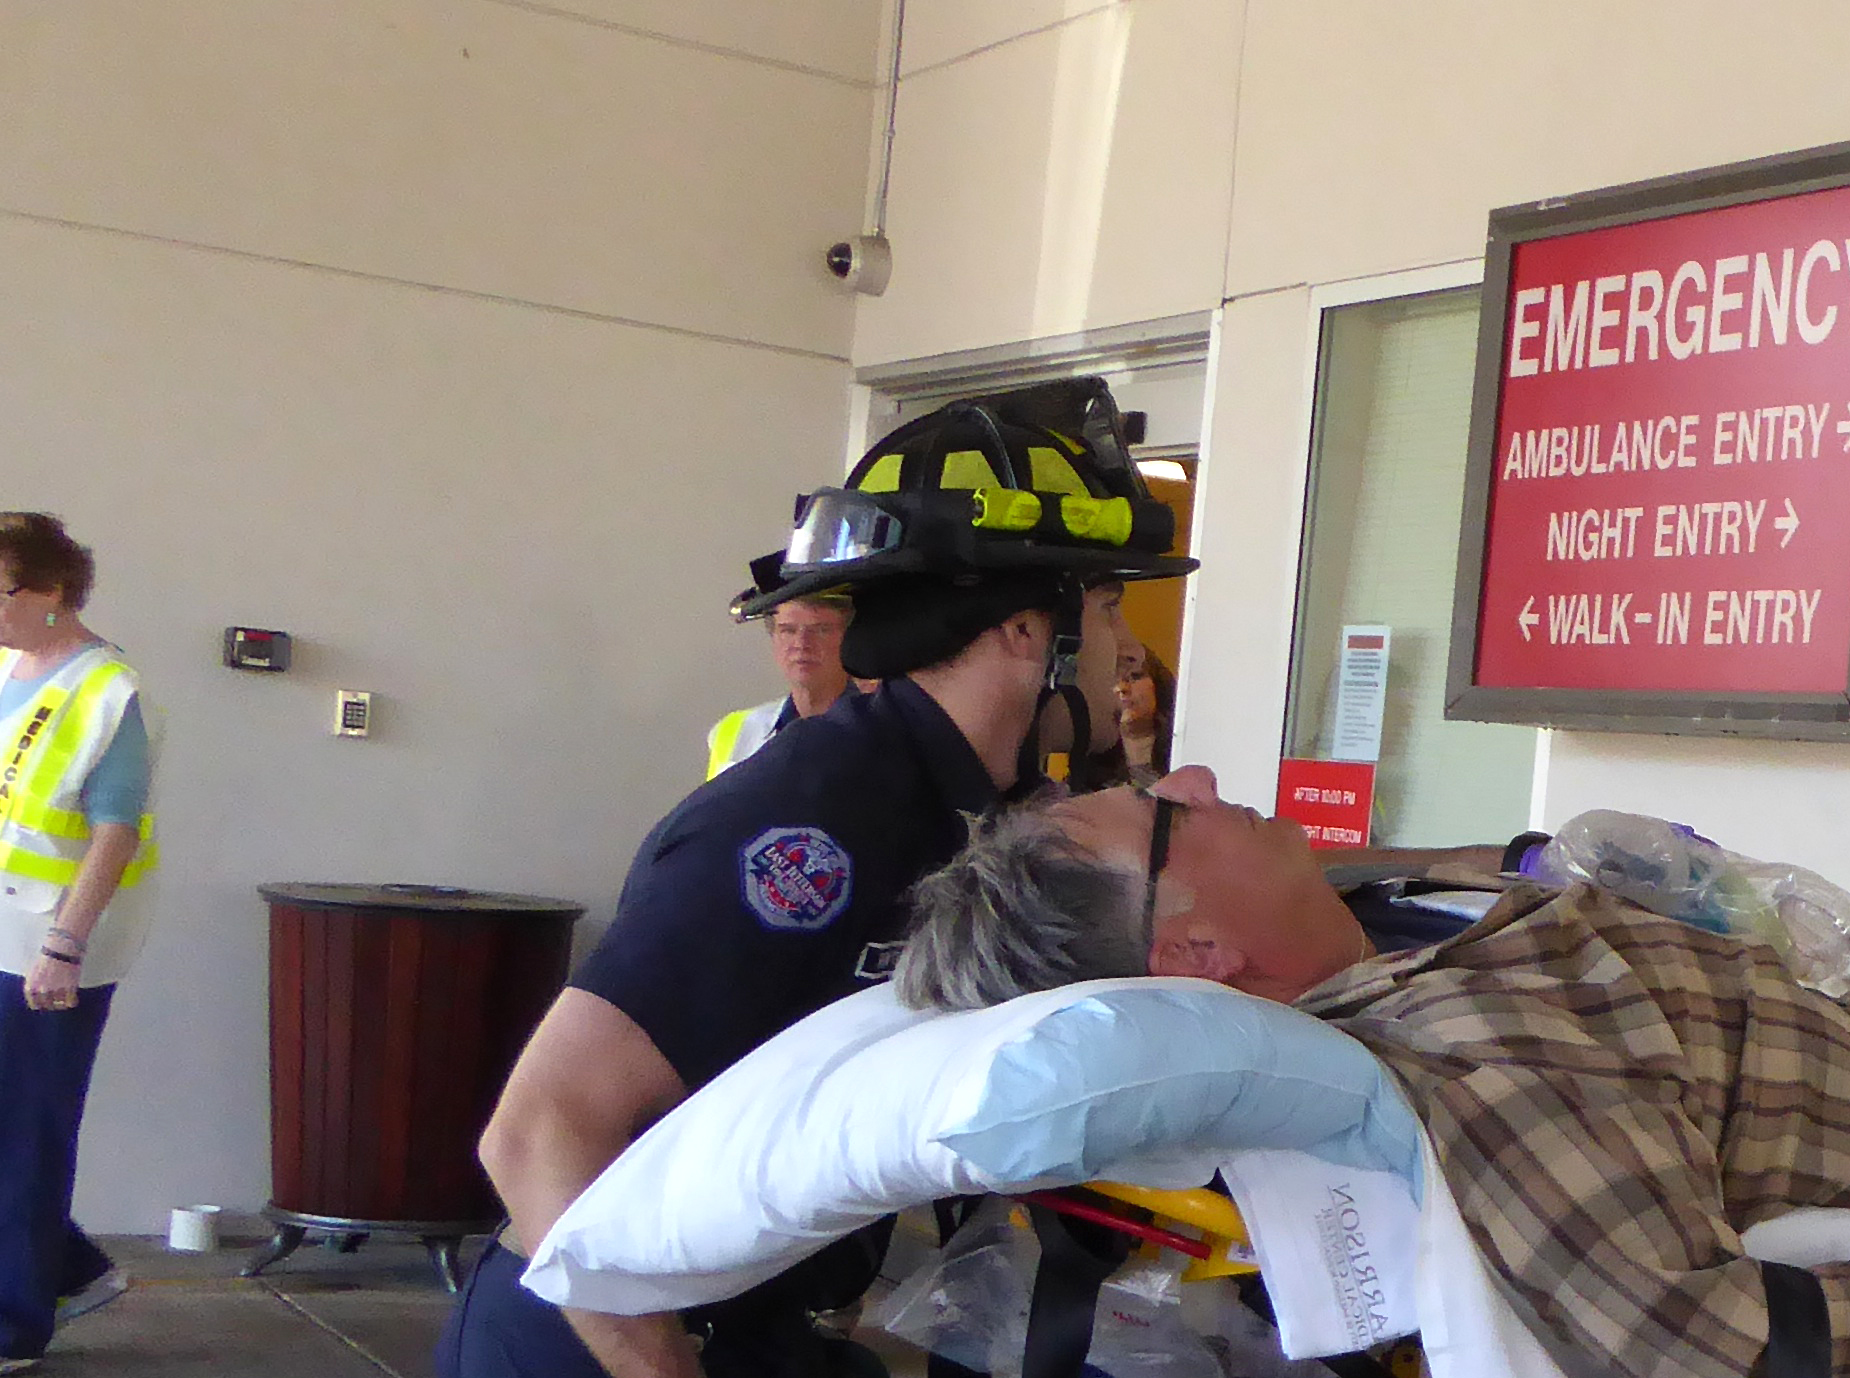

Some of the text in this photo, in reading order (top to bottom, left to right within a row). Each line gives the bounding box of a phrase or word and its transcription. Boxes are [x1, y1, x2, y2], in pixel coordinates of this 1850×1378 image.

[1504, 403, 1831, 479] AMBULANCE ENTRY
[1546, 499, 1767, 560] NIGHT ENTRY
[1548, 589, 1822, 645] WALK-IN ENTRY
